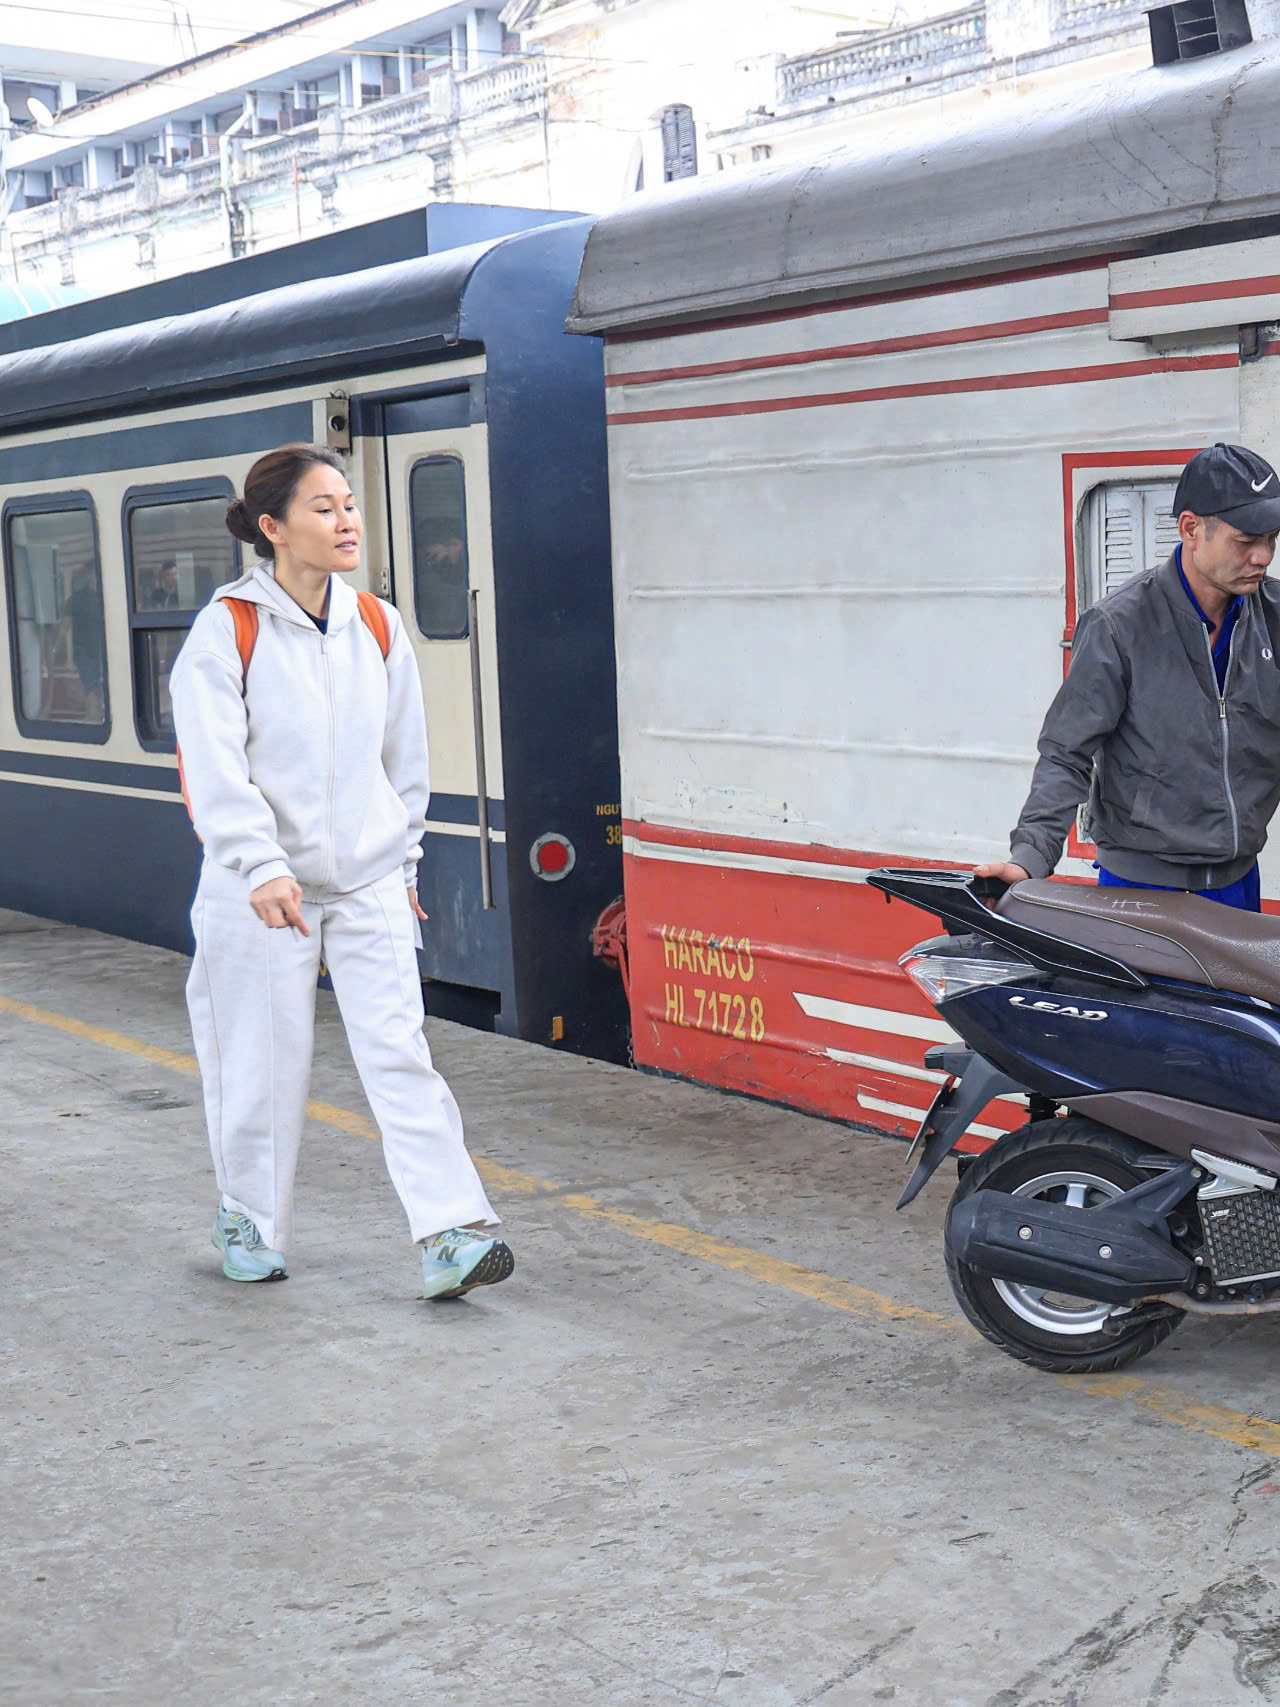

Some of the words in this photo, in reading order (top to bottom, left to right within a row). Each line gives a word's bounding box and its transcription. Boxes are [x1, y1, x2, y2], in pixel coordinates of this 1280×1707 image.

[596, 804, 622, 816] NGU
[661, 924, 754, 982] HARACO
[664, 983, 690, 1027] HL
[694, 988, 765, 1041] 71728
[1008, 996, 1108, 1021] LEAD
[437, 1245, 458, 1262] N
